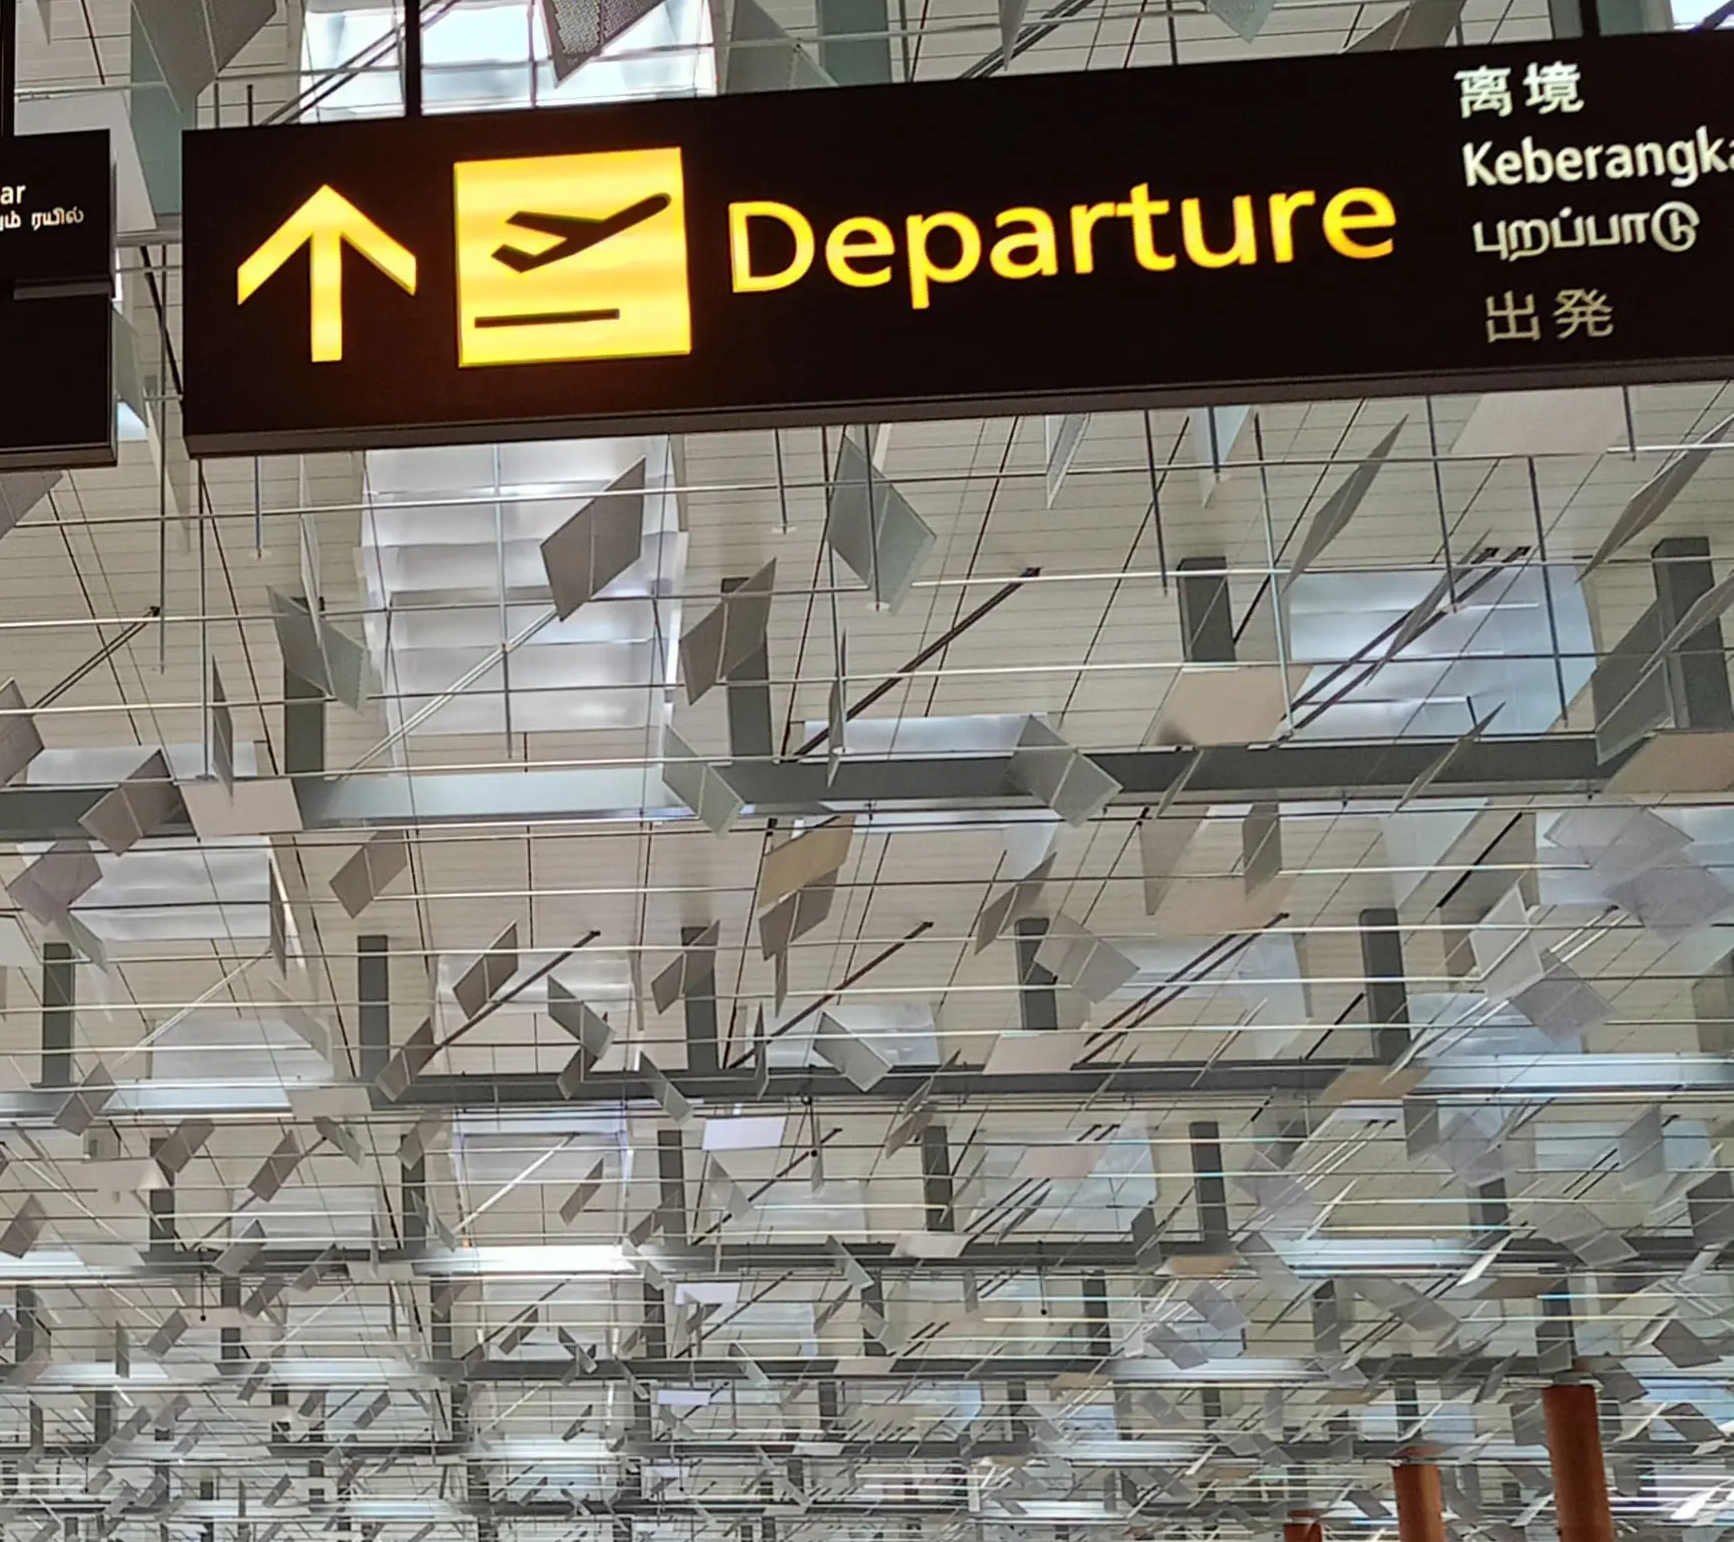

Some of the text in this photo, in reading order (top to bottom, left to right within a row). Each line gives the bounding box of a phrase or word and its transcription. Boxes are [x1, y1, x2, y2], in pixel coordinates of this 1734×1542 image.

[1454, 60, 1585, 119] 离境
[1462, 125, 1734, 188] Keberangk
[727, 182, 1397, 310] Departure
[1472, 201, 1700, 262] புறப்பாடு
[1485, 287, 1614, 343] 出発
